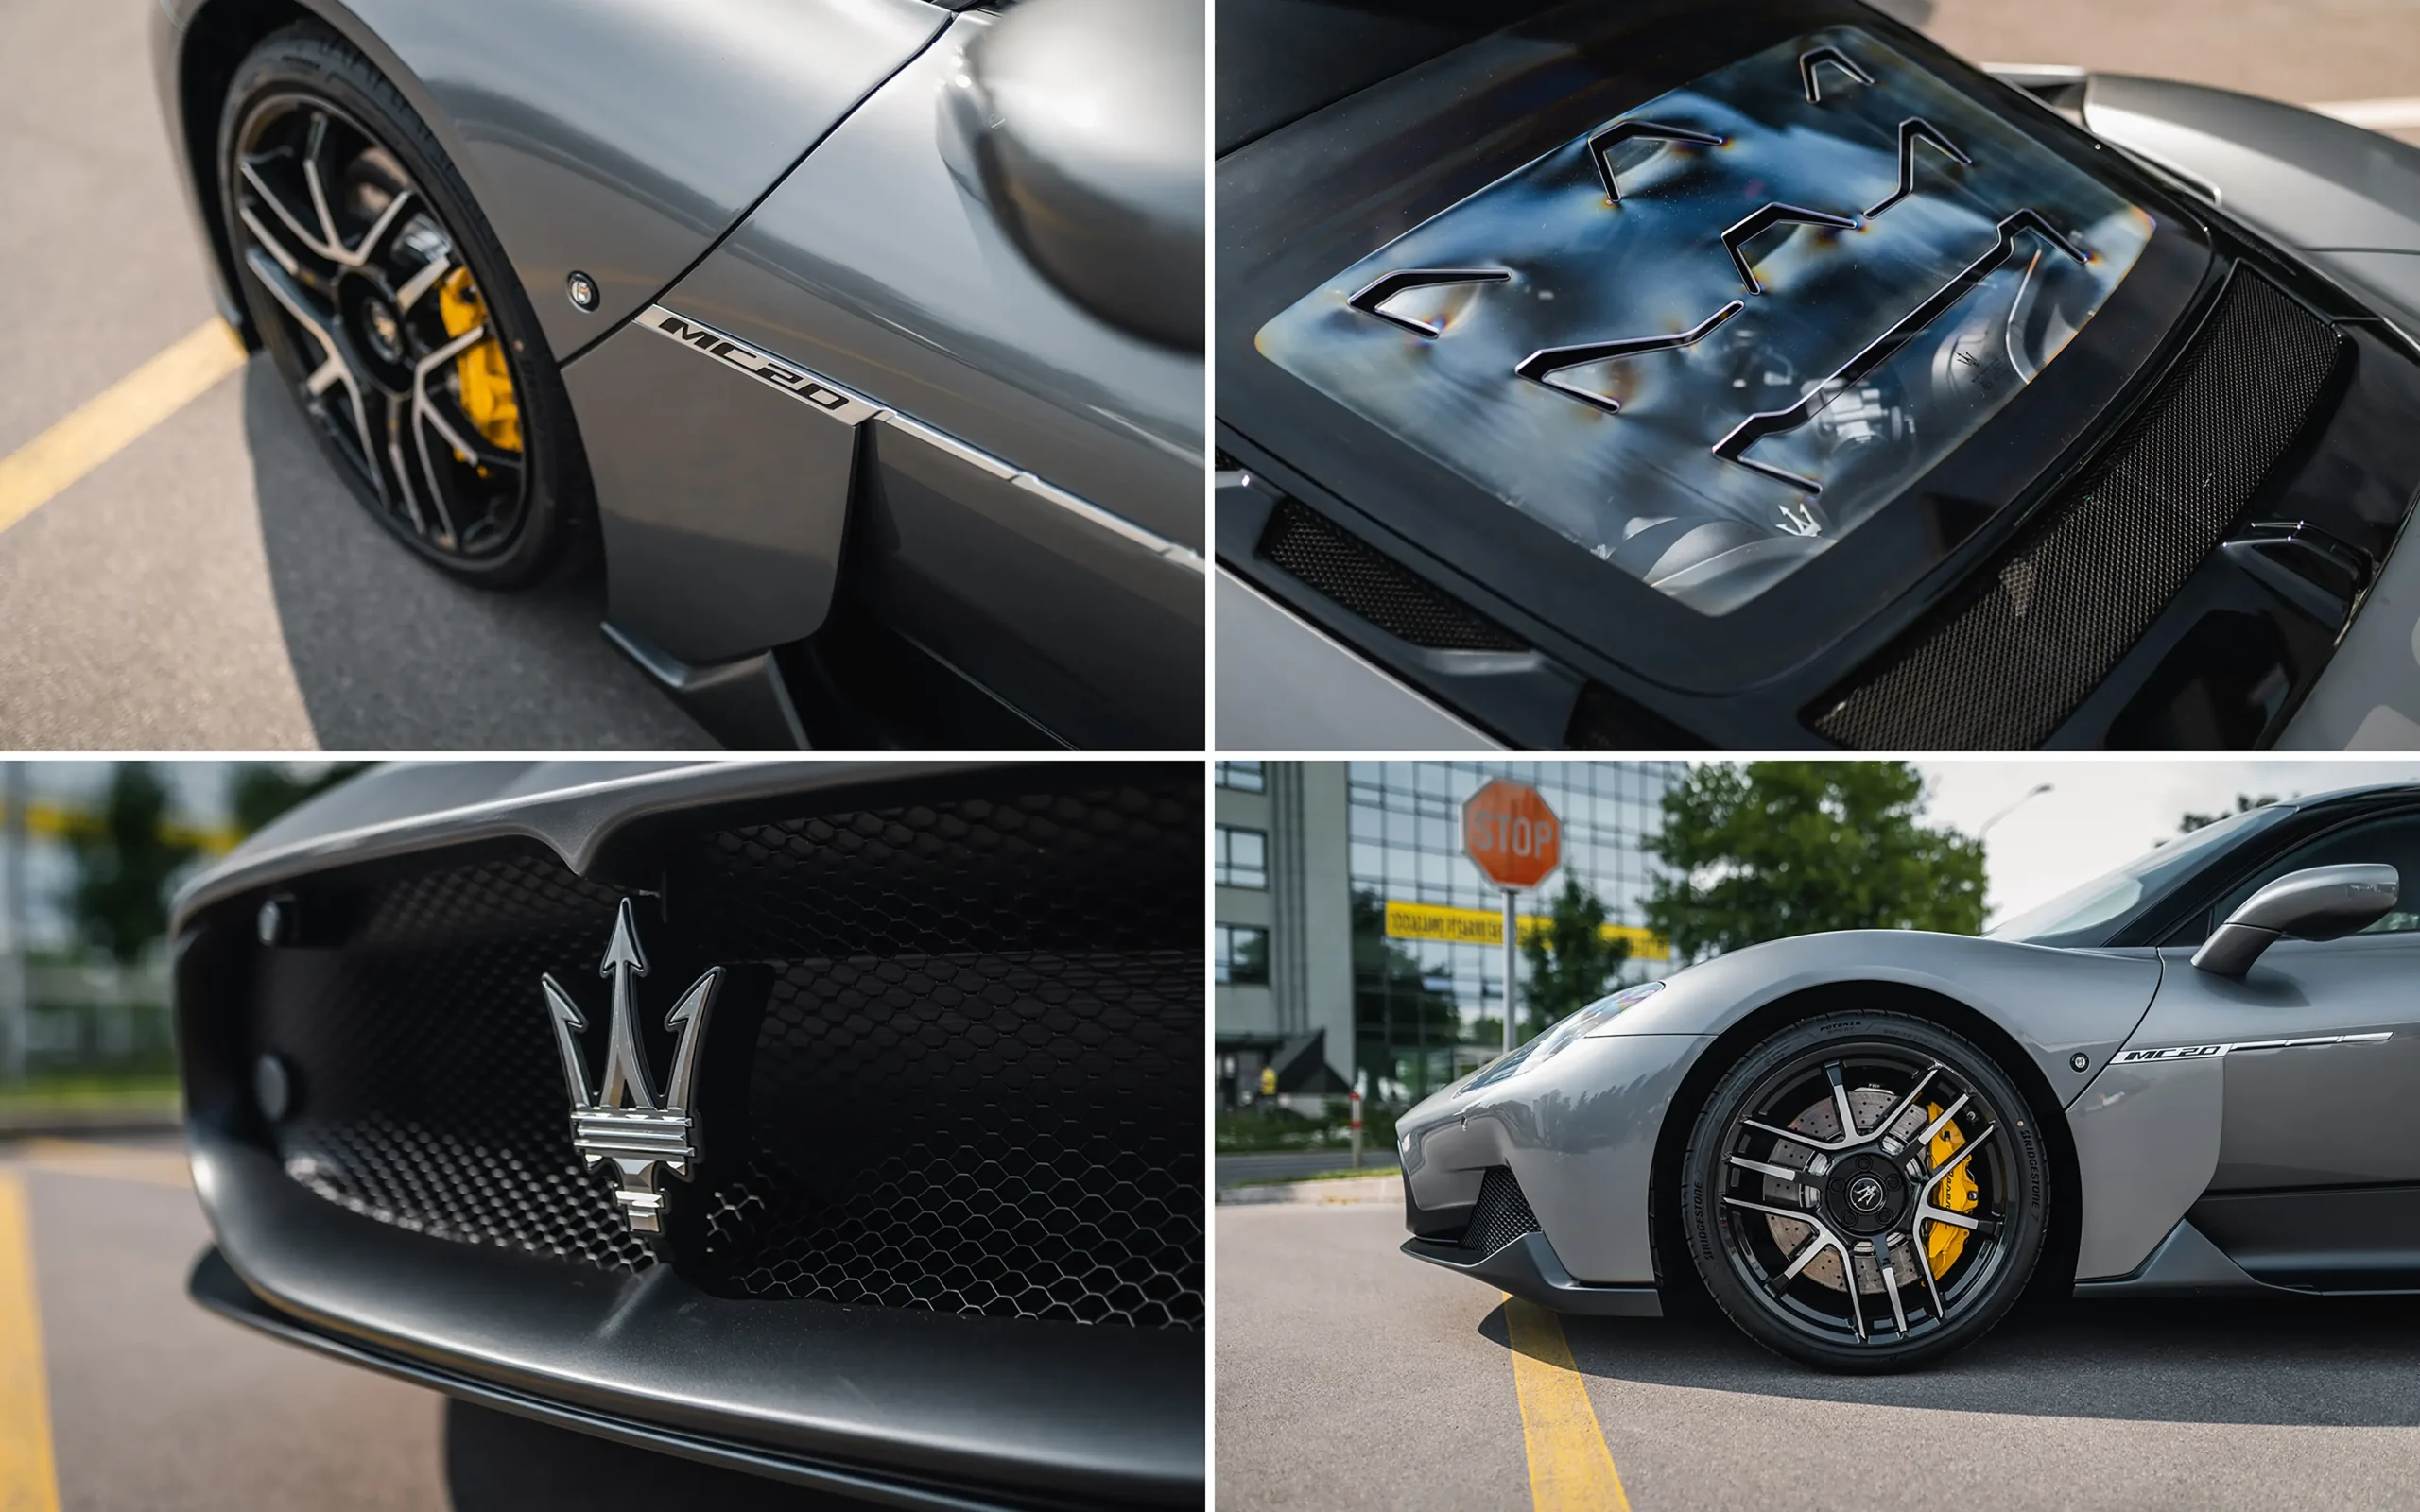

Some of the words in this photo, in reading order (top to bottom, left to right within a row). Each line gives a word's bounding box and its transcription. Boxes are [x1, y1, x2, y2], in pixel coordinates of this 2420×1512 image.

[658, 317, 850, 410] MC20
[1475, 810, 1552, 859] STOP
[1819, 1021, 1861, 1032] POTENZA
[2124, 1046, 2221, 1060] MC20
[2019, 1129, 2041, 1209] BRIDGESTONE
[1694, 1181, 1714, 1260] BRIDGESTONE
